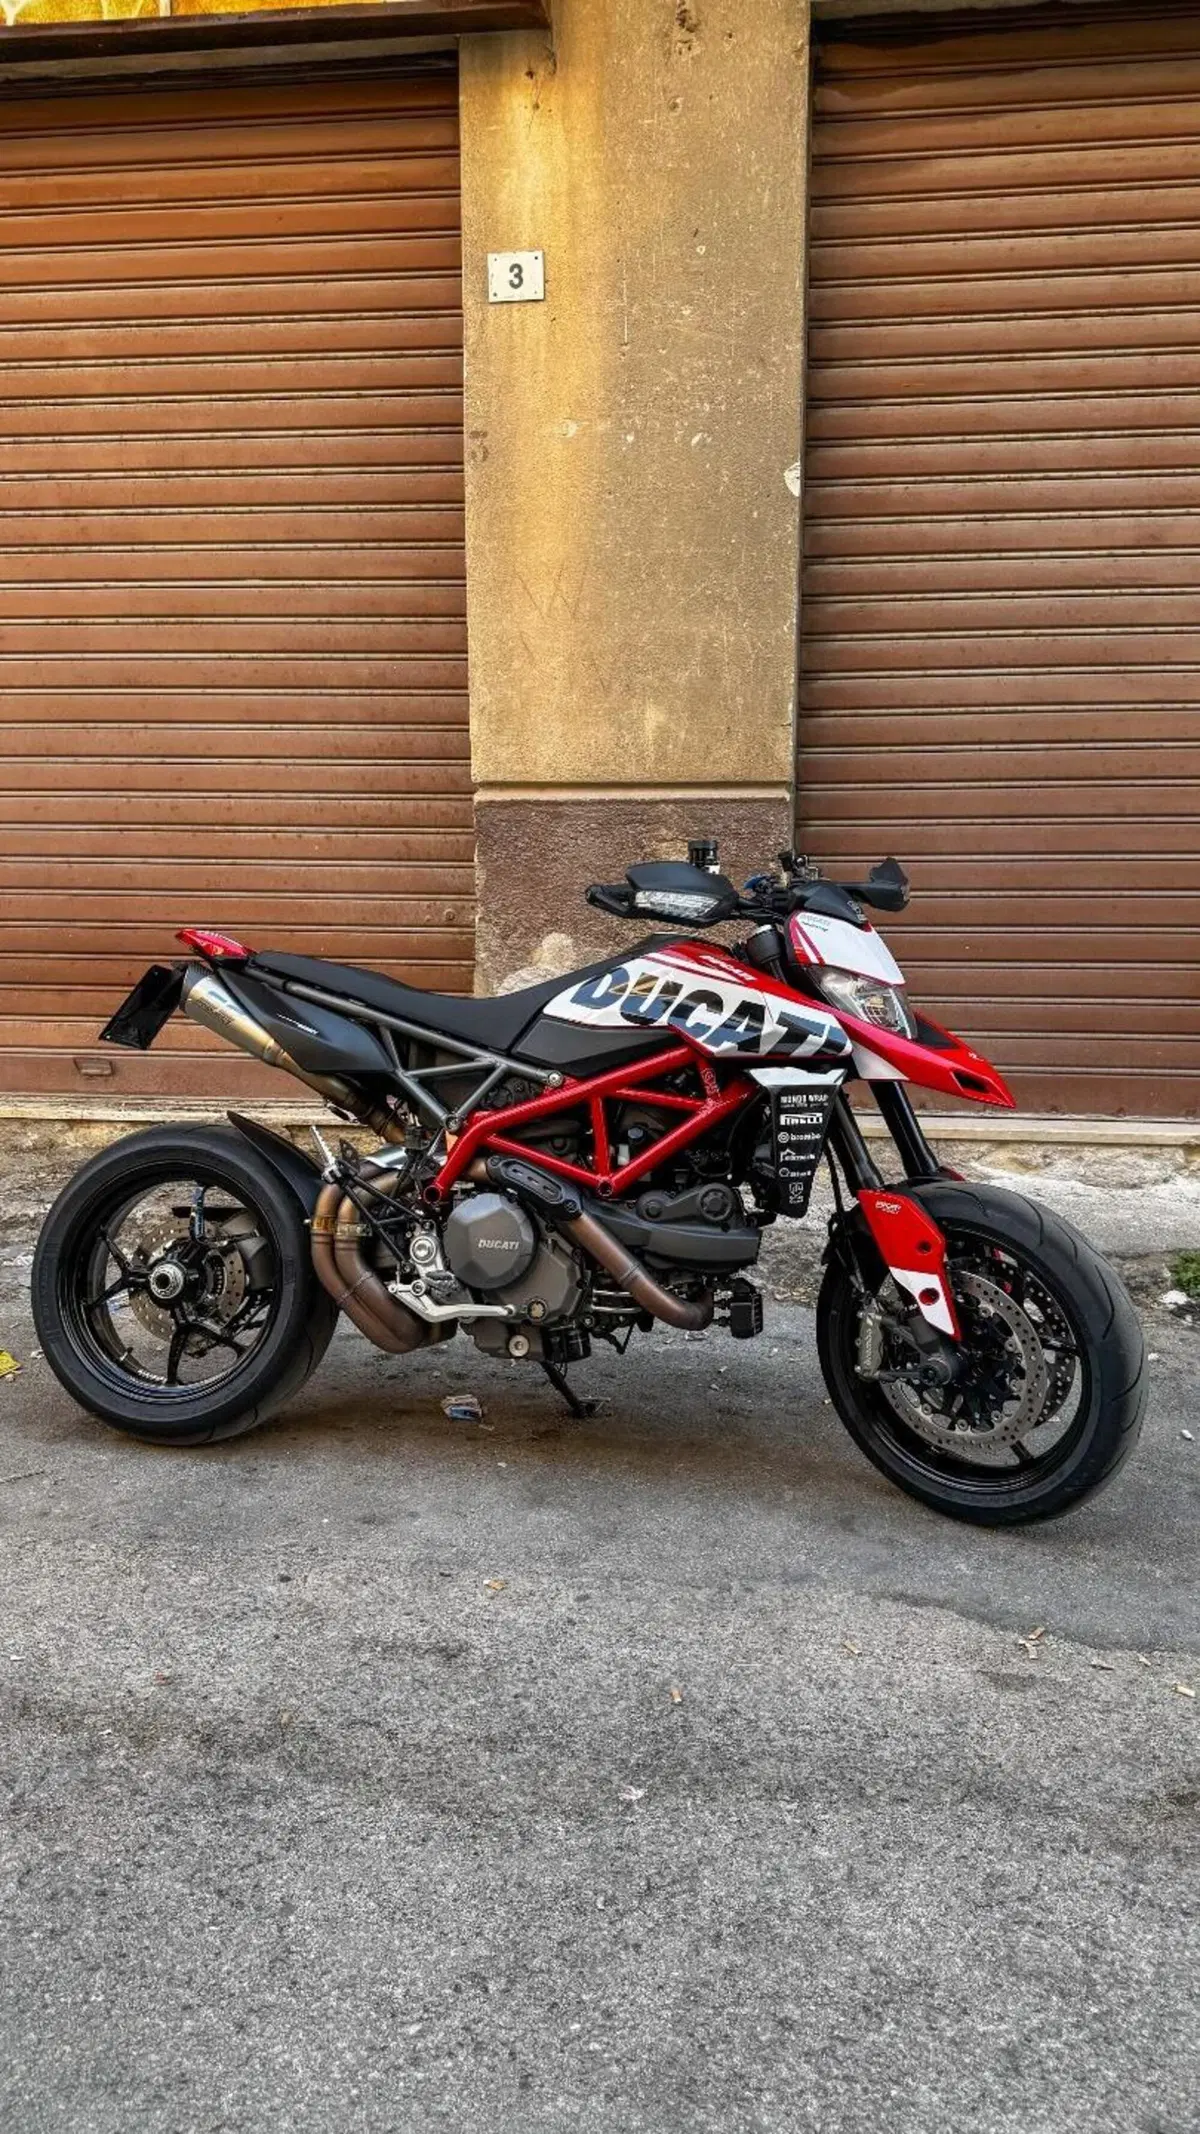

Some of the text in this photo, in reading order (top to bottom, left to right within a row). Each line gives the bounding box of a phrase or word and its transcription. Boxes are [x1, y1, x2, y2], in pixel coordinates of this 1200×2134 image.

[509, 263, 523, 289] 3
[570, 967, 850, 1056] DUCATI
[780, 1112, 823, 1126] PIRELLI
[478, 1239, 520, 1250] DUCATI
